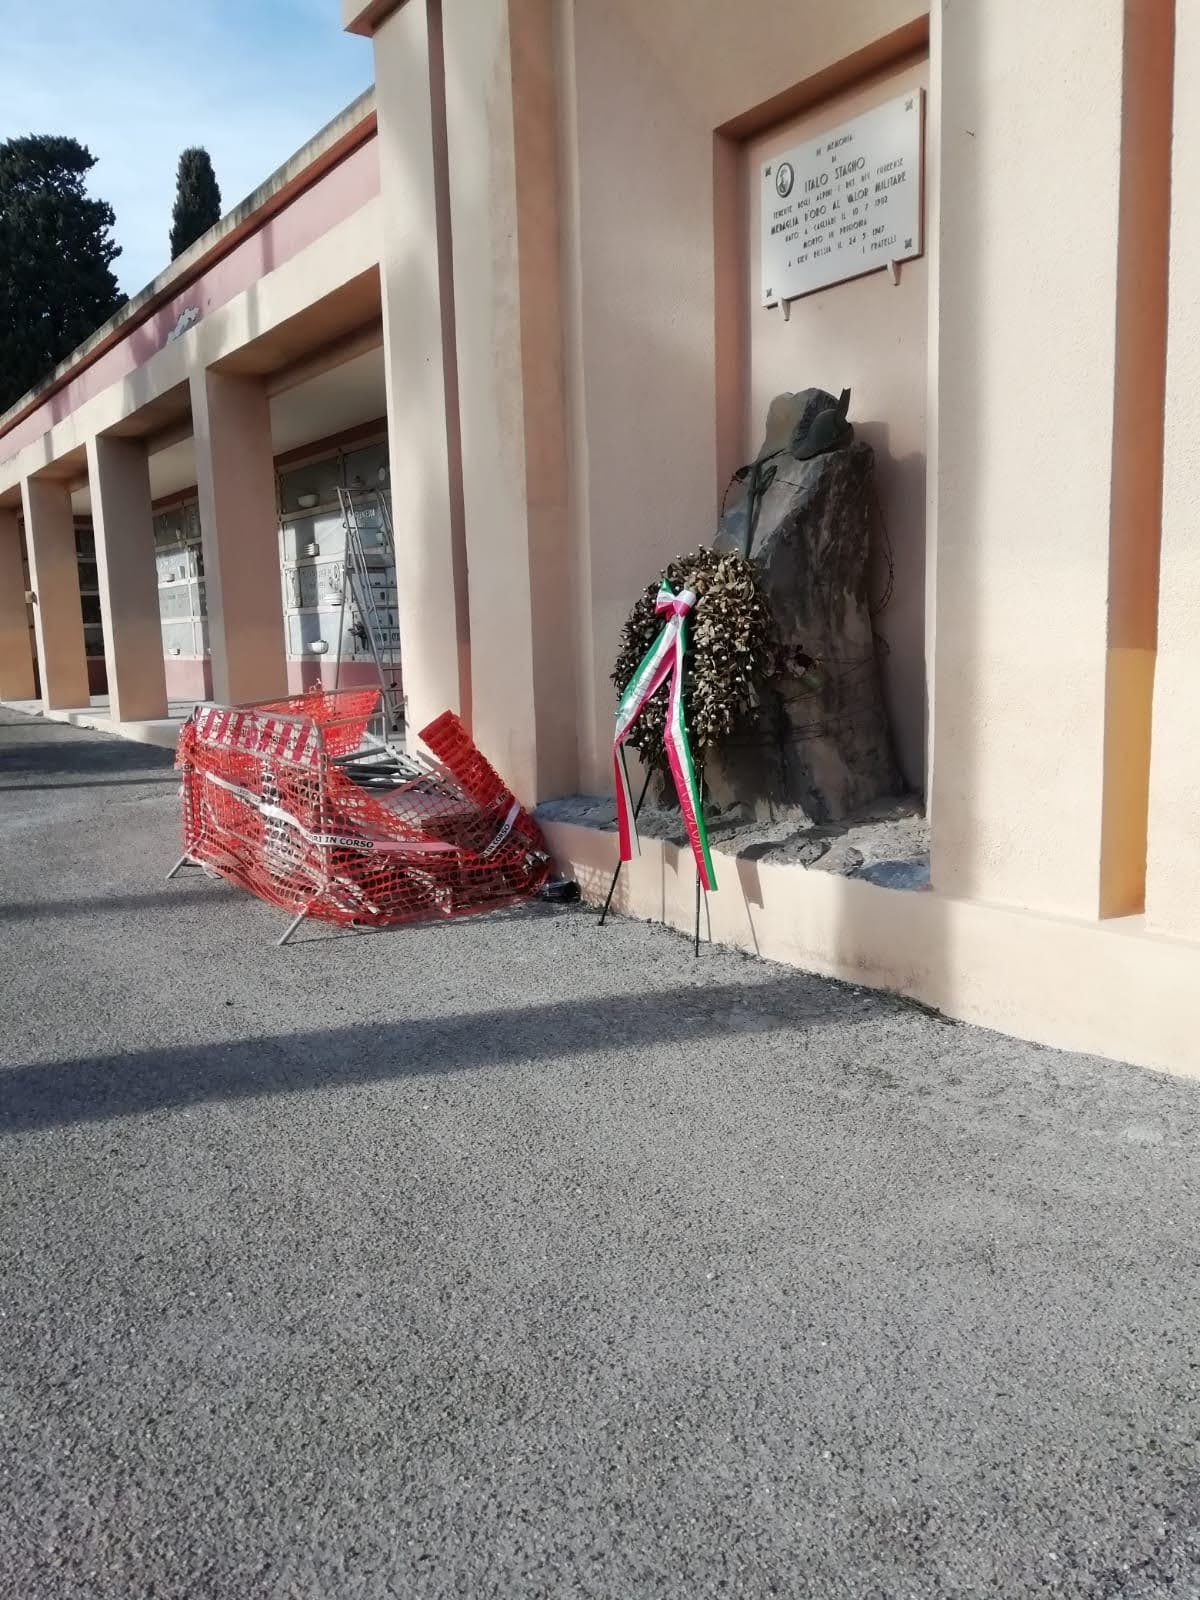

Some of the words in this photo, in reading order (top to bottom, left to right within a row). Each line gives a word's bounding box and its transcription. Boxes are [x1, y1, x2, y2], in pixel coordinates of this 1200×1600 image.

[827, 135, 852, 152] MEMORIA
[805, 173, 828, 192] ITALO
[835, 157, 865, 180] STAGNO
[771, 216, 798, 234] MEDAGLIA
[804, 205, 826, 222] D'ORO
[833, 200, 840, 210] AL
[847, 187, 868, 203] VALOR
[875, 171, 906, 192] MILITARE
[774, 205, 792, 219] TENENTE
[798, 198, 810, 208] DEGLI
[816, 189, 832, 201] ALPINI
[785, 232, 799, 242] NATO
[814, 216, 836, 231] CAGLIARI
[853, 208, 858, 216] 10
[803, 235, 823, 248] MORTO
[871, 235, 896, 251] FRATELLI
[813, 246, 831, 258] RUSSIA
[340, 838, 374, 848] CORSO
[493, 824, 510, 845] CORSO
